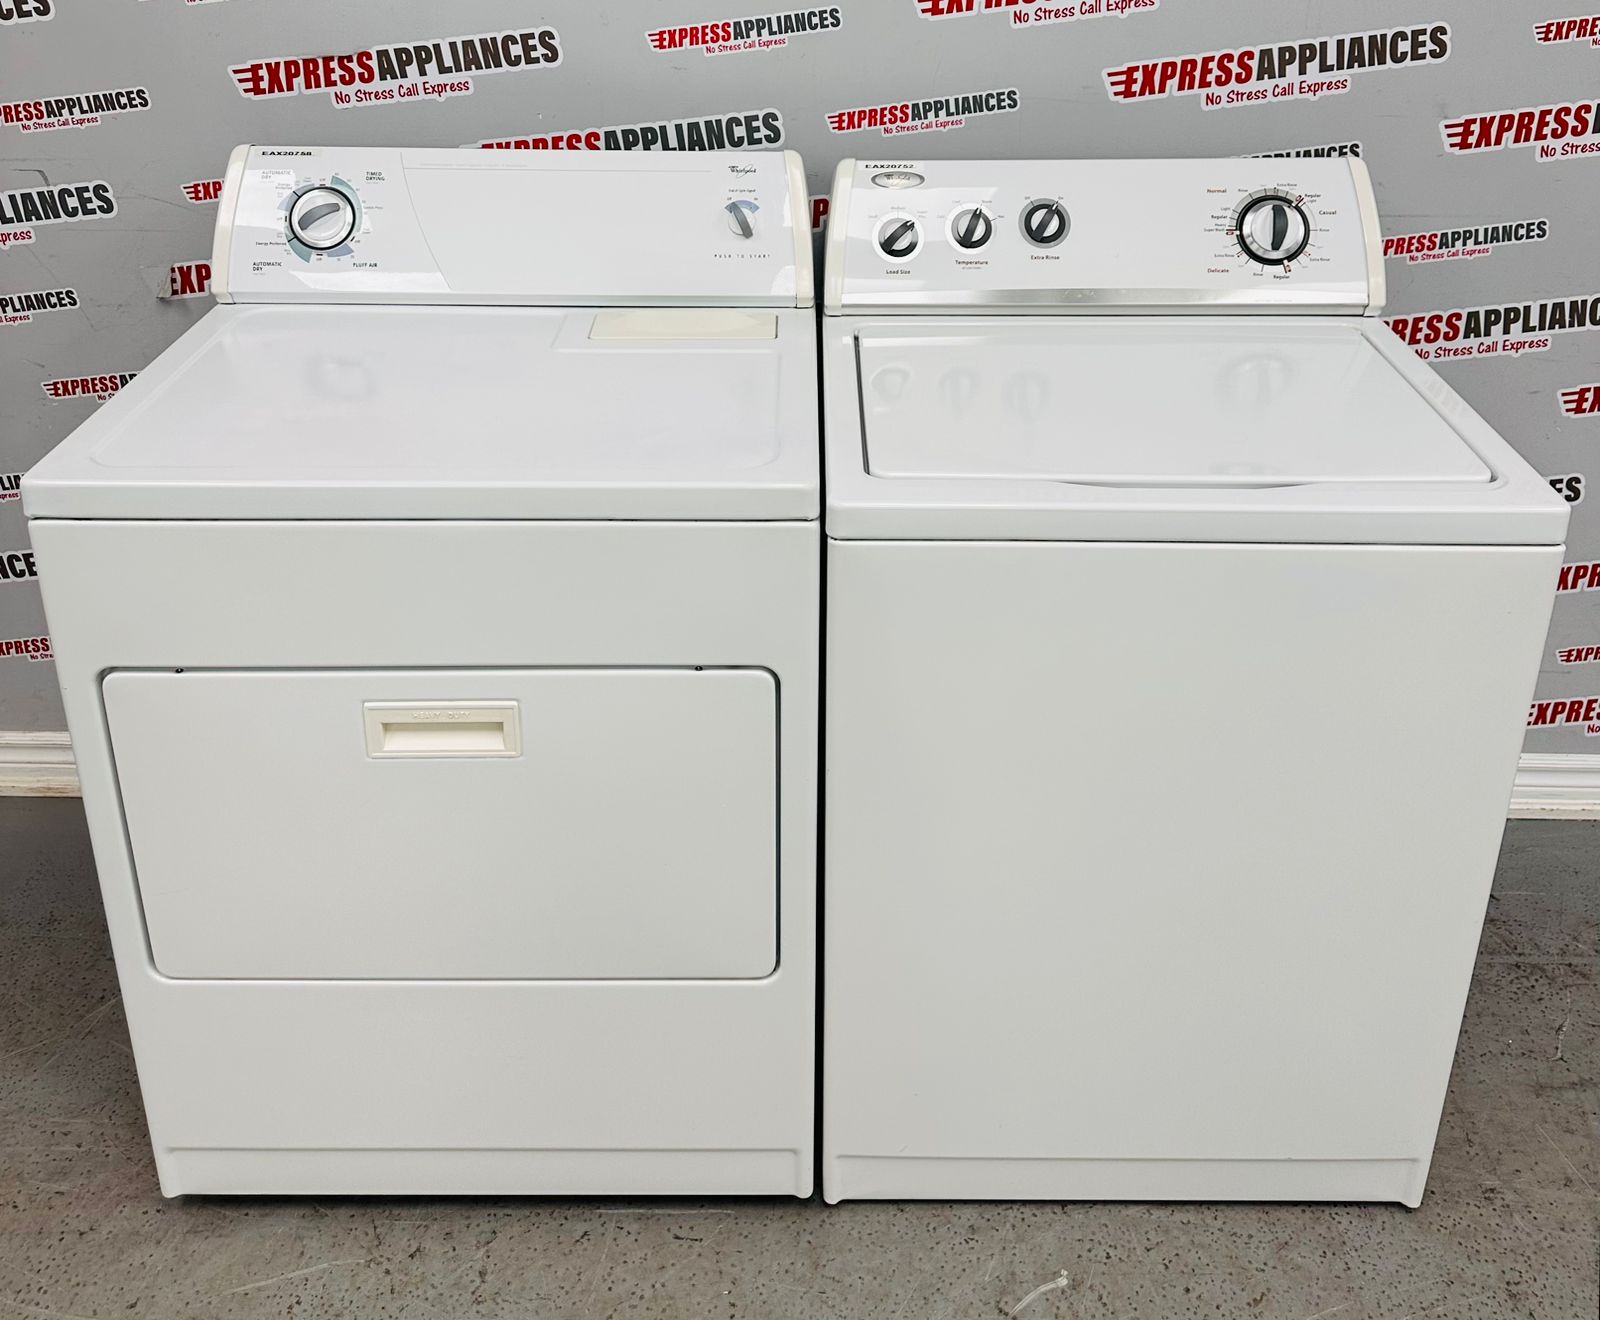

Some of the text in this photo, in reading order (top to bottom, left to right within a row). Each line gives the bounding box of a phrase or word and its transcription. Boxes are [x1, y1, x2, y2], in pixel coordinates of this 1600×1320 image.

[1013, 11, 1029, 24] No
[1034, 8, 1075, 21] Stress
[1080, 1, 1101, 15] Call
[1535, 17, 1600, 42] EXPRE
[706, 38, 786, 54] No Stress Call Express
[334, 80, 470, 105] No Stress Call Express
[1205, 78, 1348, 106] No Stress Call Express
[21, 116, 99, 131] No Stress Call Express
[883, 118, 963, 135] No Stress Call Express
[1540, 145, 1557, 158] No
[0, 230, 32, 246] press
[1409, 246, 1490, 263] No Stress Call Express
[4, 315, 30, 324] Express
[1434, 346, 1473, 359] Stress
[1478, 341, 1498, 354] Call
[1503, 337, 1549, 354] Express
